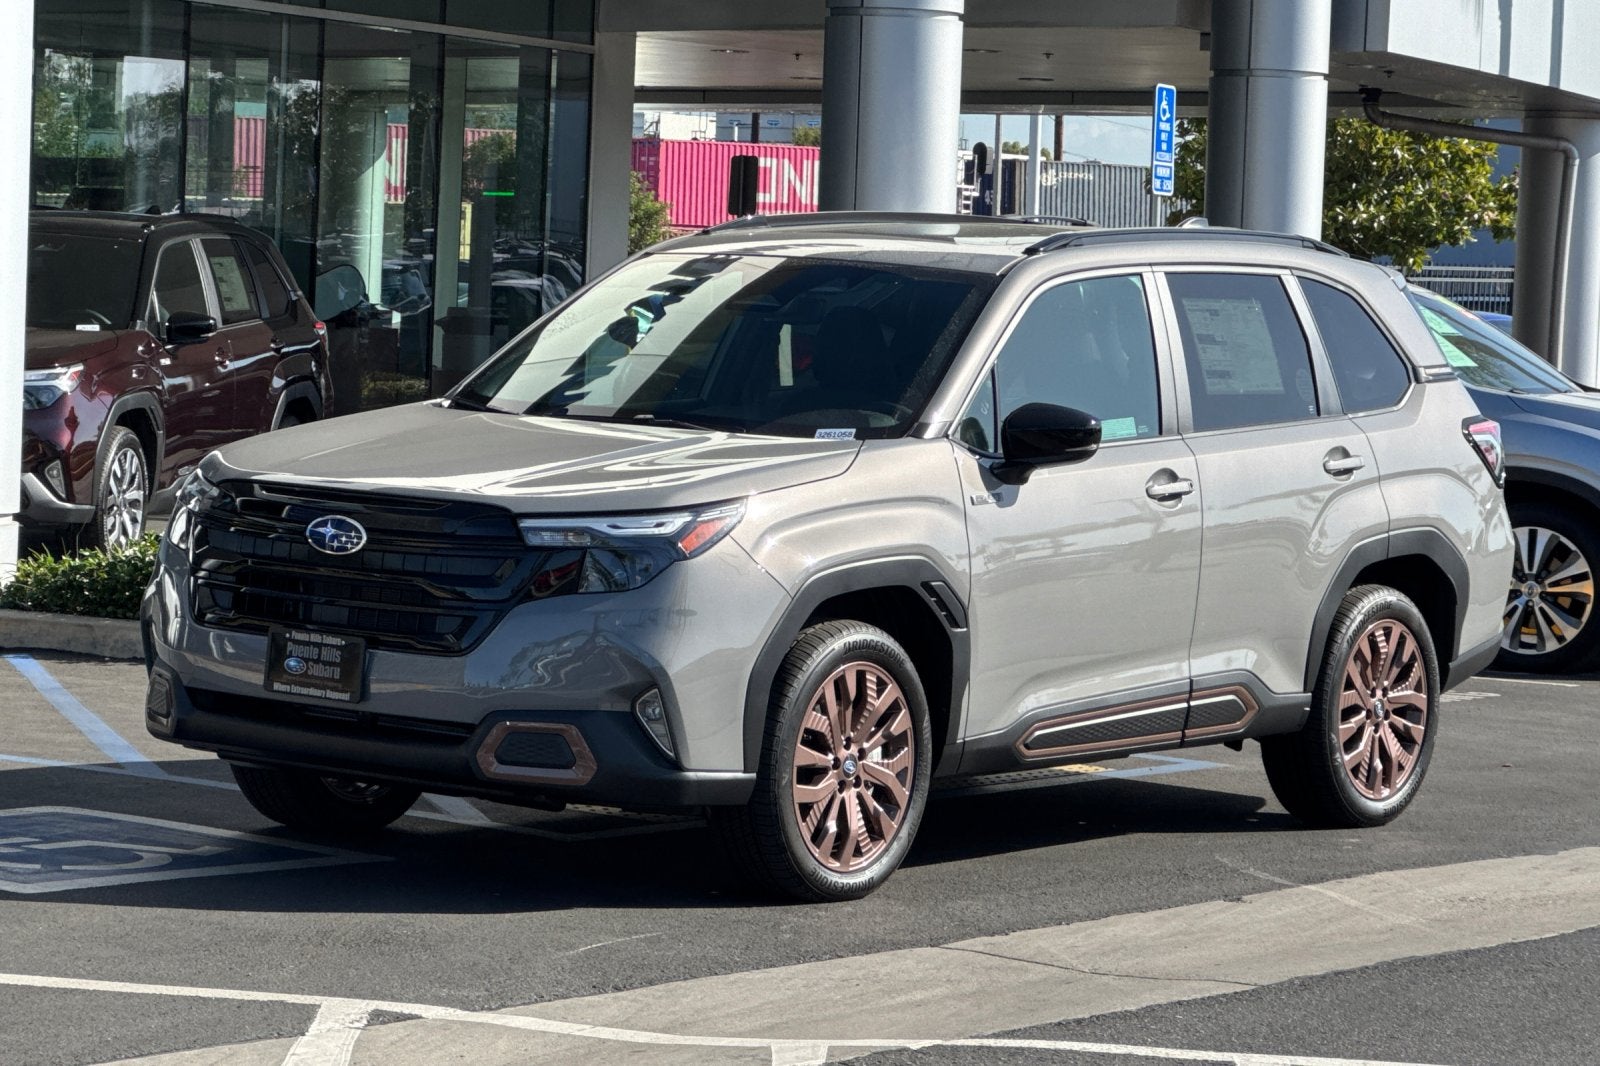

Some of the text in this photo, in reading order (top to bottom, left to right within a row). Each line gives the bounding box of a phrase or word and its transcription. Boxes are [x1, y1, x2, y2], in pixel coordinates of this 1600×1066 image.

[1347, 600, 1393, 648] BRIDGESTONE
[286, 641, 342, 663] Puente Hills
[843, 639, 905, 668] BRIDGESTONE
[307, 661, 340, 680] Subaru
[273, 681, 291, 693] Where
[291, 684, 326, 698] Extraordinary
